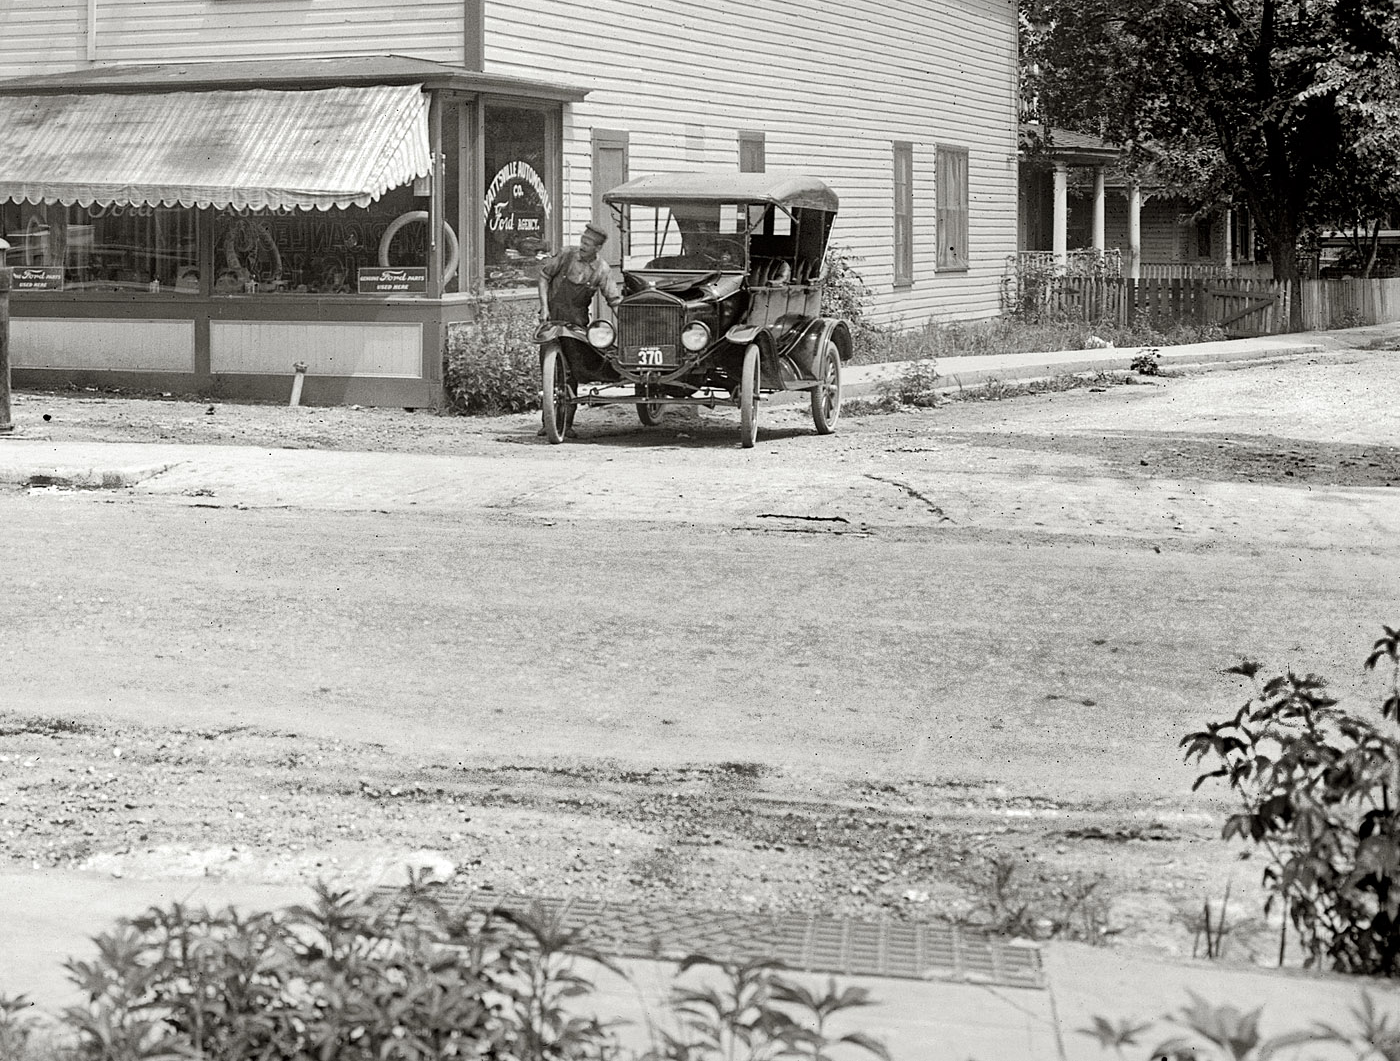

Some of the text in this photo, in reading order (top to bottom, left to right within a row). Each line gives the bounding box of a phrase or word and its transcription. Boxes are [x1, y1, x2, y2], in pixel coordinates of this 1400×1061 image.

[489, 201, 515, 231] Ford
[21, 269, 46, 280] Ford
[380, 270, 407, 281] Ford
[638, 350, 663, 365] 370
